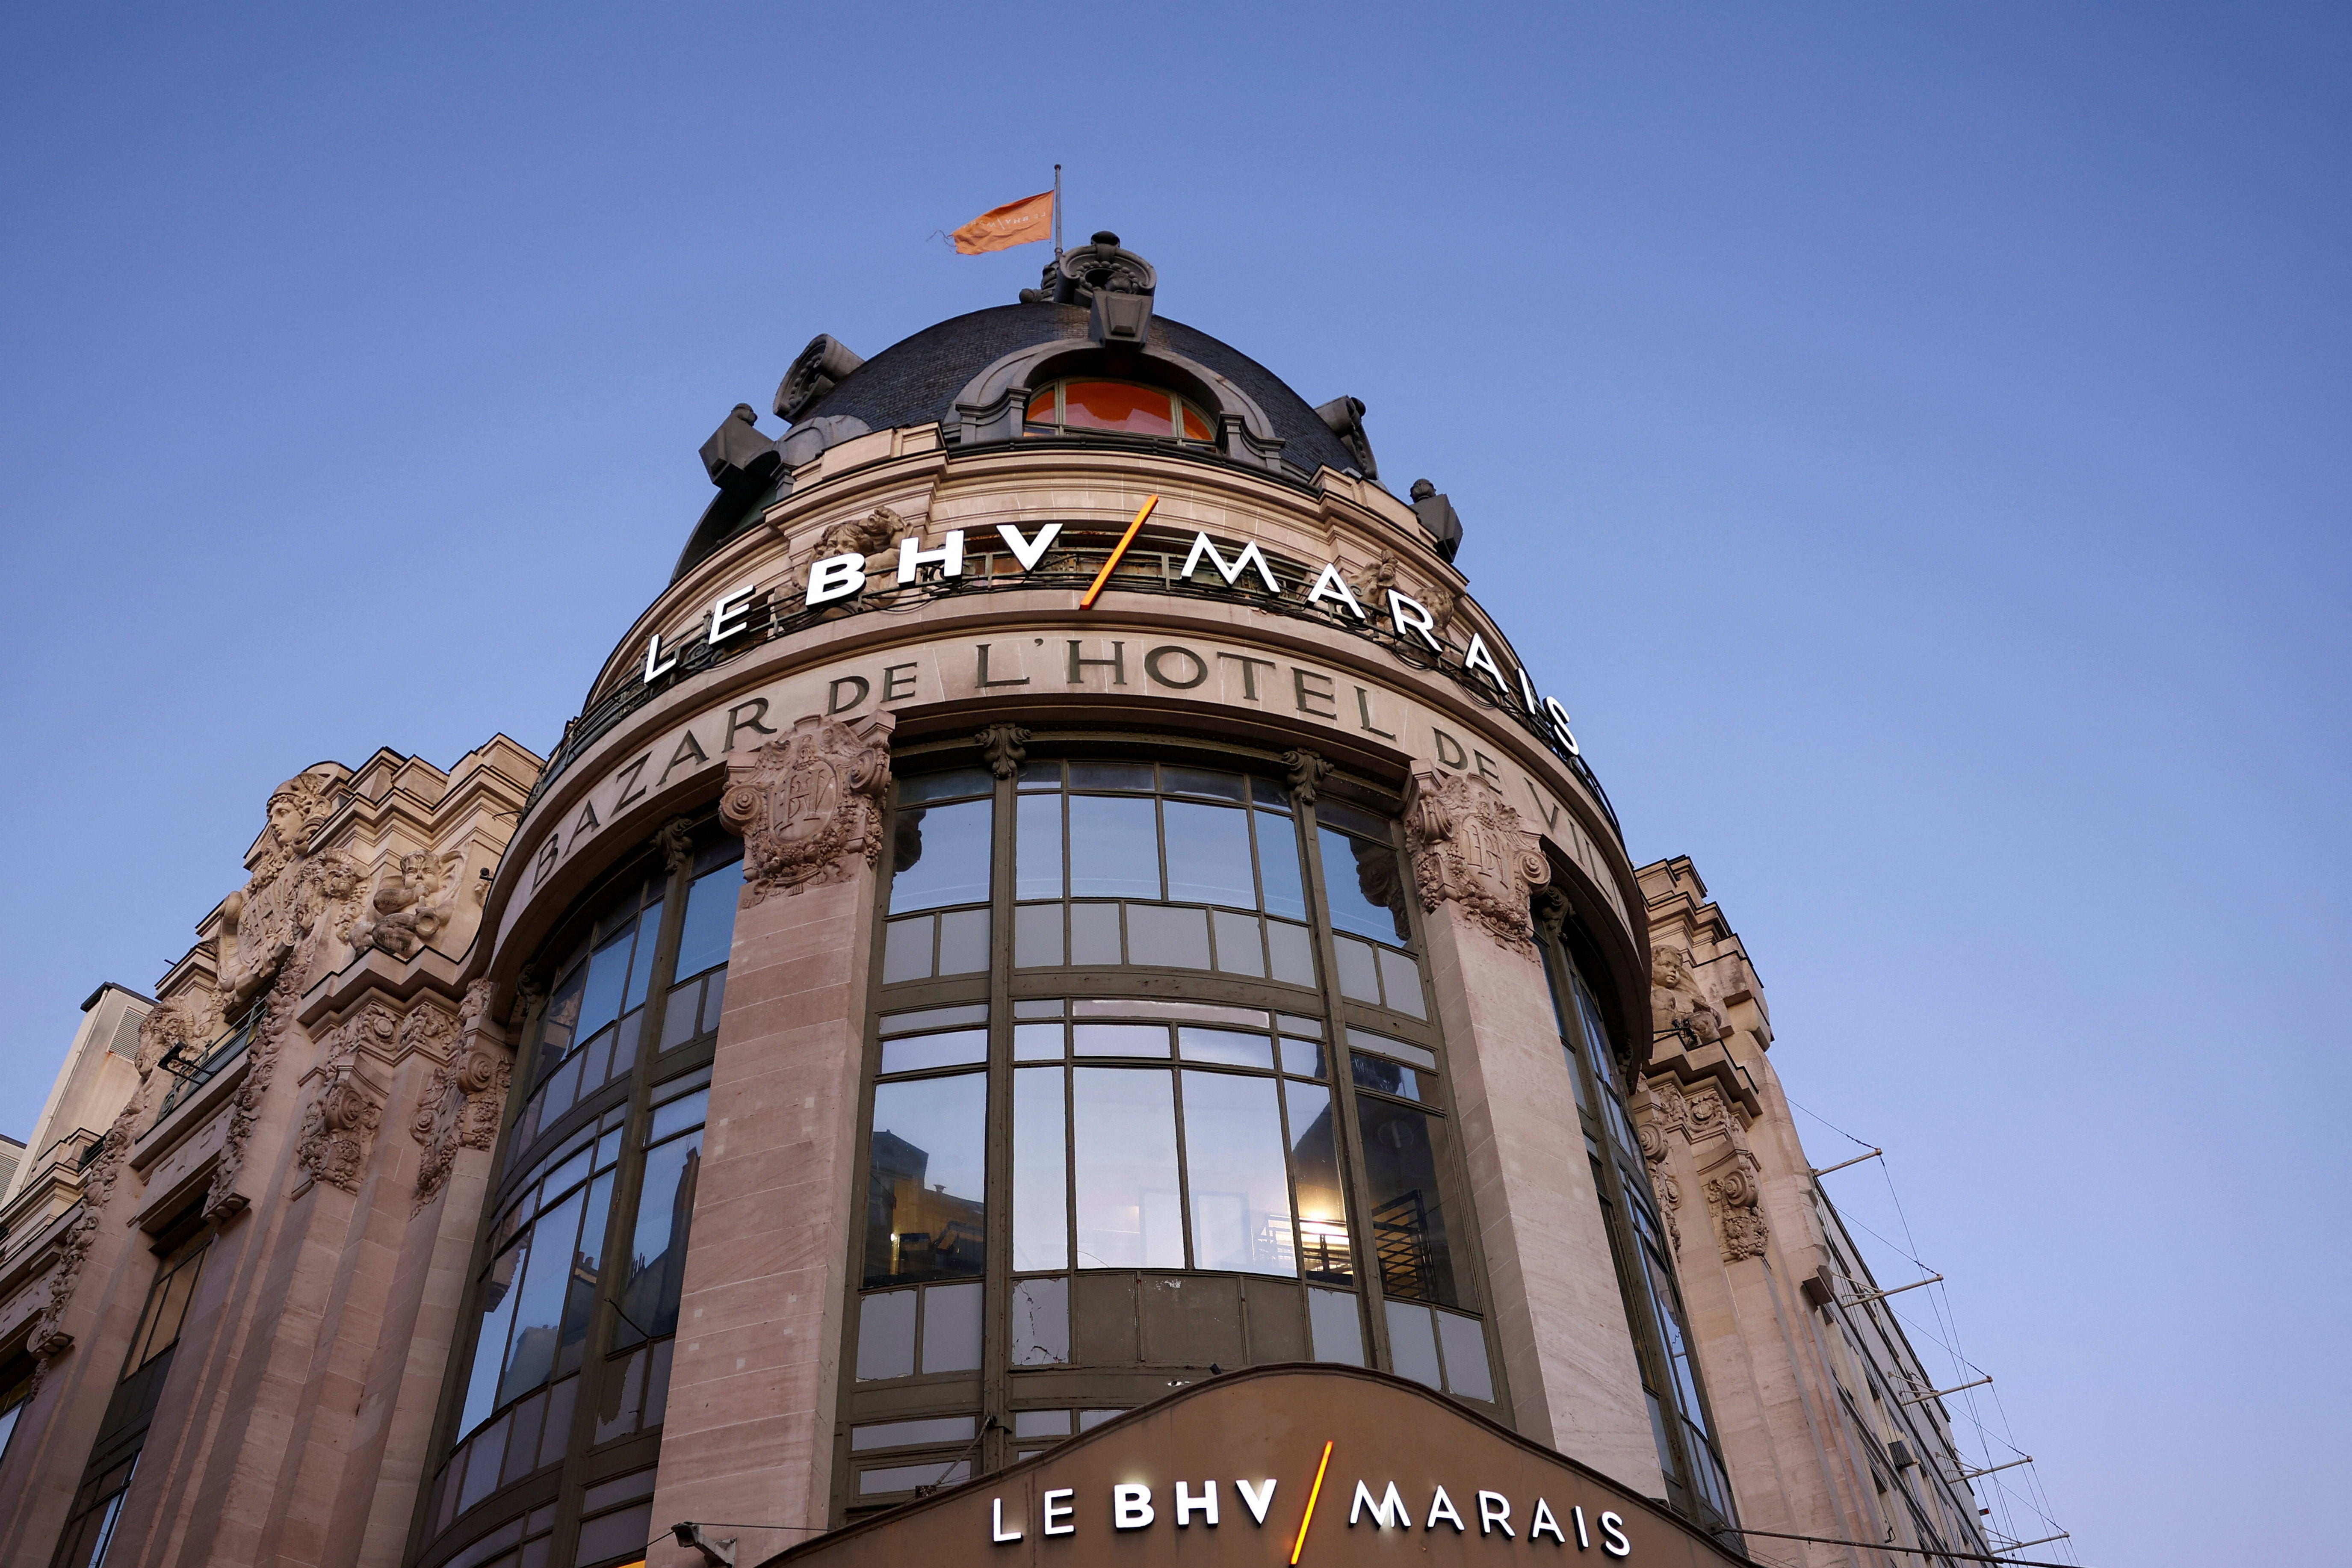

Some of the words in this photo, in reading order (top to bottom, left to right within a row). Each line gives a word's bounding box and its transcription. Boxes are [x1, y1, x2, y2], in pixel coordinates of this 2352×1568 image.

[644, 584, 755, 684] LE
[806, 523, 1063, 606] BHV
[1181, 531, 1579, 756] MARAIS
[530, 697, 777, 895] BAZAR
[825, 662, 917, 716] DE
[1432, 726, 1503, 796] DE
[993, 1488, 1074, 1542] LE
[1114, 1479, 1277, 1530] BHV
[1349, 1479, 1630, 1556] MARAIS
